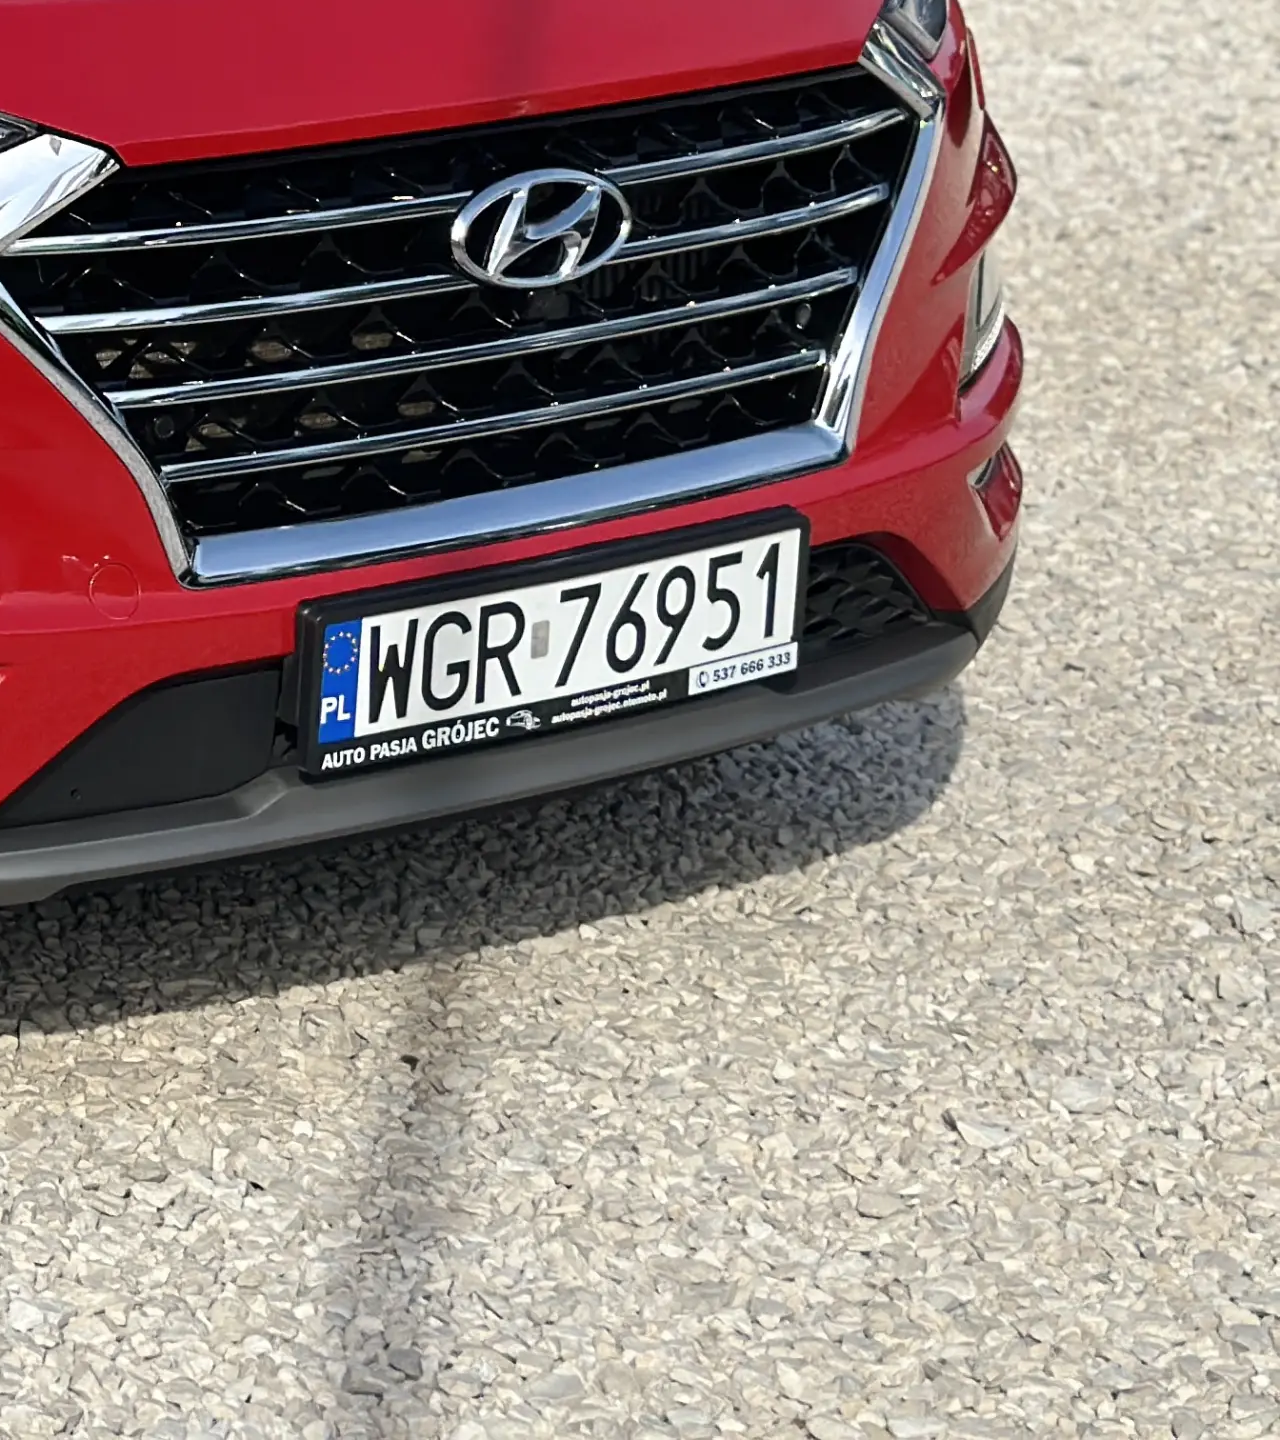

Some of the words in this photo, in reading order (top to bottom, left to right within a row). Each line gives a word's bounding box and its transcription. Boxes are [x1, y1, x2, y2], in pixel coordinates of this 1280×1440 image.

[368, 601, 525, 724] WGR
[554, 542, 781, 688] 76951
[713, 665, 736, 682] 537
[740, 658, 764, 675] 666
[767, 651, 791, 668] 333
[319, 694, 351, 724] PL
[321, 747, 366, 770] AUTO
[369, 736, 418, 760] PASJA
[420, 716, 500, 750] GRÓJEC
